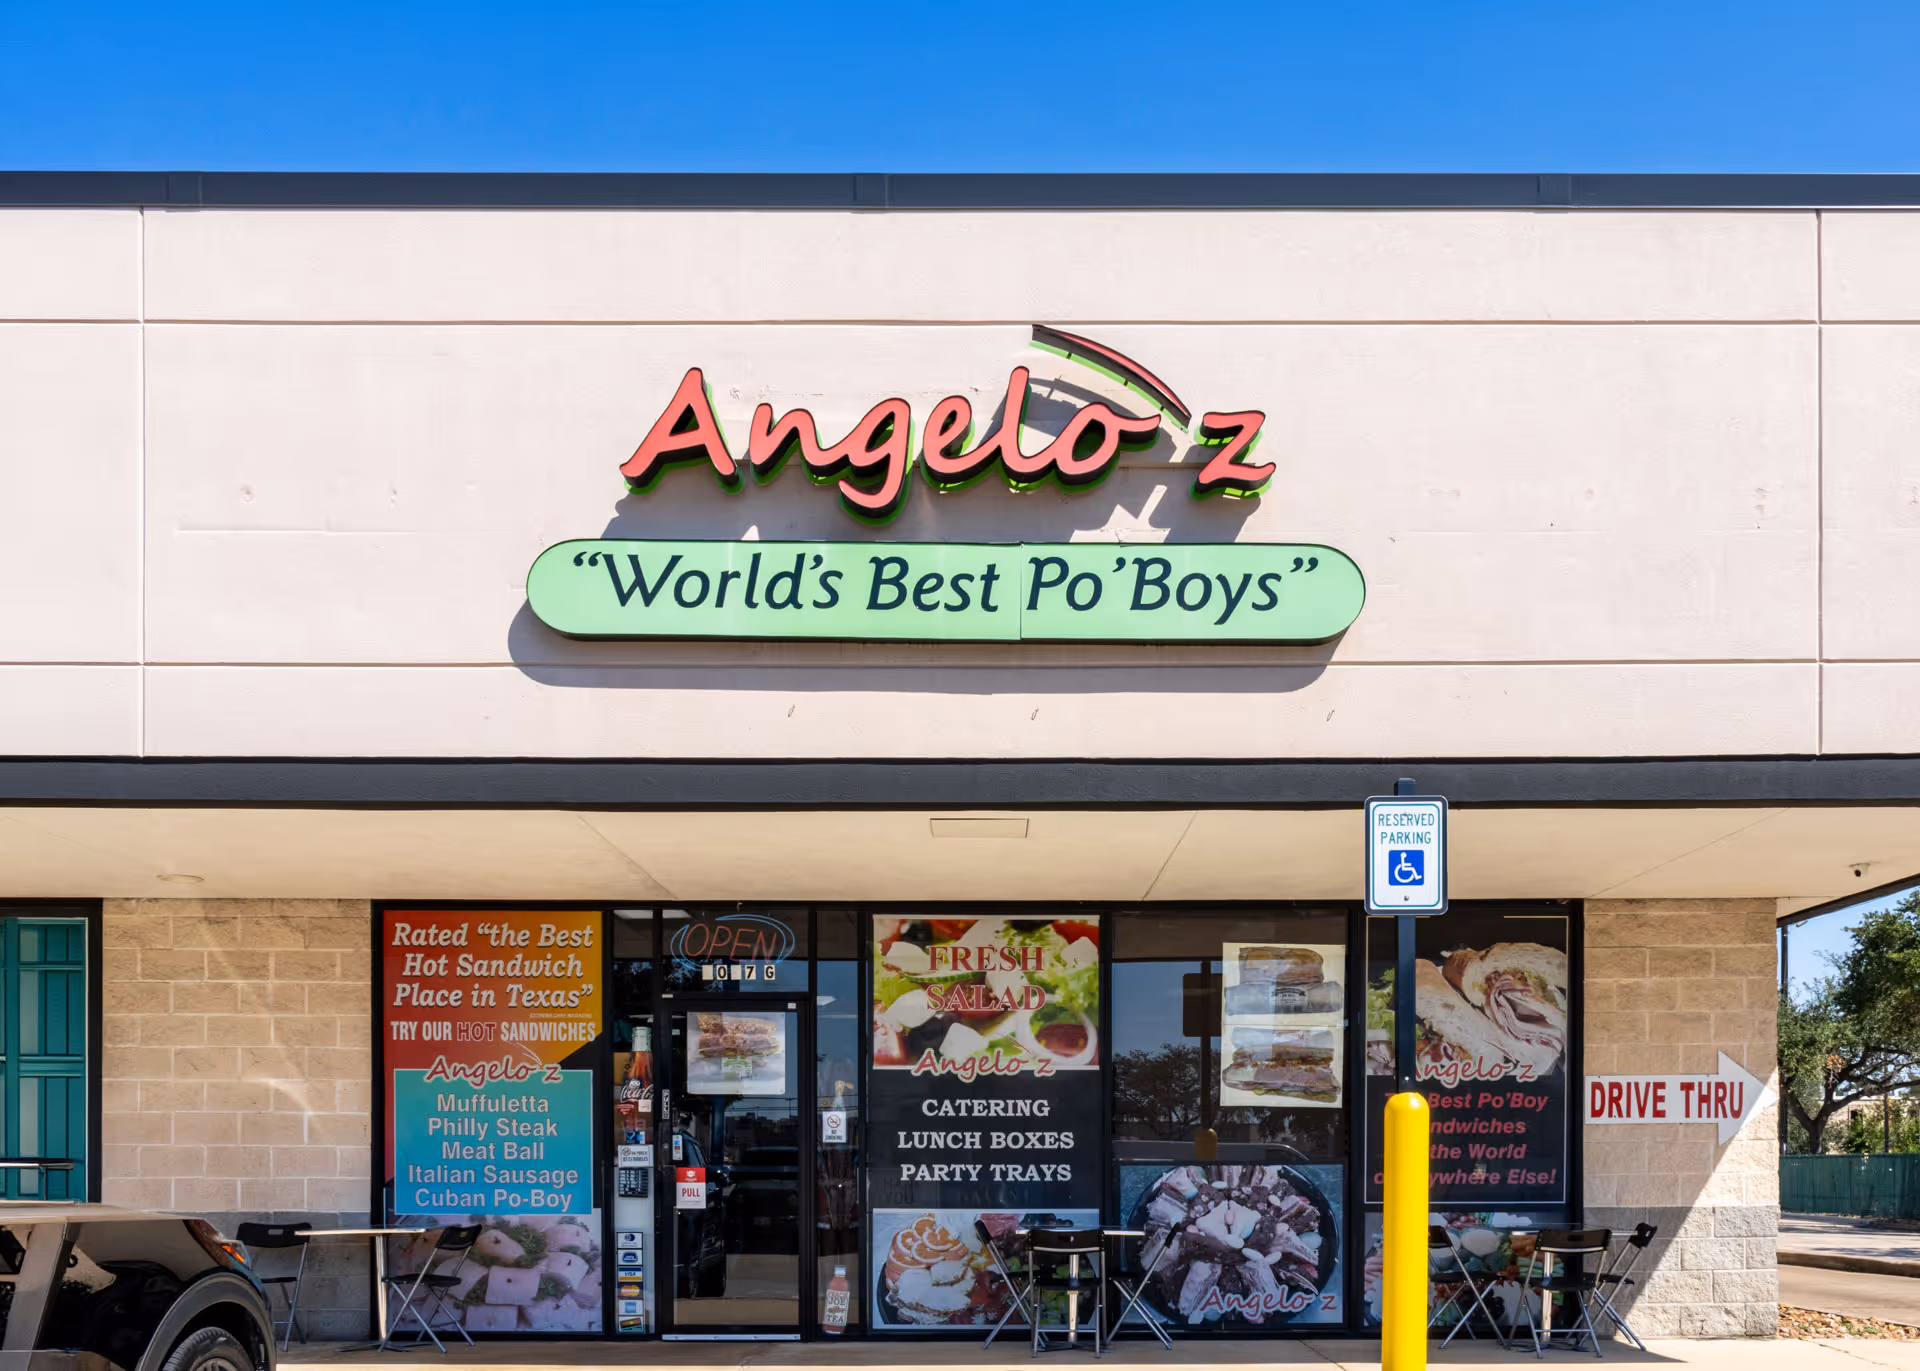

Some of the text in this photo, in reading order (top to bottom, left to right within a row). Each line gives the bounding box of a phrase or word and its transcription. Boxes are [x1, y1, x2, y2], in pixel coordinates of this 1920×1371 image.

[866, 556, 1000, 612] Best
[1378, 813, 1435, 827] RESERVED
[1381, 831, 1431, 845] PARKING
[392, 923, 594, 948] Rated "the Best
[685, 923, 776, 963] OPEN
[402, 953, 584, 978] Hot Sandwich
[928, 945, 1045, 972] FRESH
[393, 983, 594, 1009] Place in Texas"
[926, 983, 1046, 1012] SALAD
[390, 1021, 596, 1042] TRY OUR HOT SANDWICHES
[437, 1094, 549, 1113] Muffuletta
[922, 1099, 1050, 1117] CATERING
[1428, 1092, 1549, 1112] Best Po'Boy
[1590, 1081, 1744, 1119] DRIVE THRU
[428, 1117, 559, 1141] Philly Steak
[1430, 1117, 1527, 1134] ndwiches
[442, 1141, 545, 1160] Meat Ball
[898, 1131, 1075, 1150] LUNCH BOXES
[1430, 1143, 1527, 1160] the World
[408, 1165, 579, 1189] Italian Sausage
[901, 1164, 1072, 1182] PARTY TRAYS
[1429, 1168, 1500, 1188] ywhere
[1506, 1168, 1557, 1185] Else!
[415, 1188, 572, 1213] Cuban Po-Boy
[682, 1188, 700, 1197] PULL
[829, 1296, 845, 1305] JOE
[826, 1315, 843, 1323] TEA
